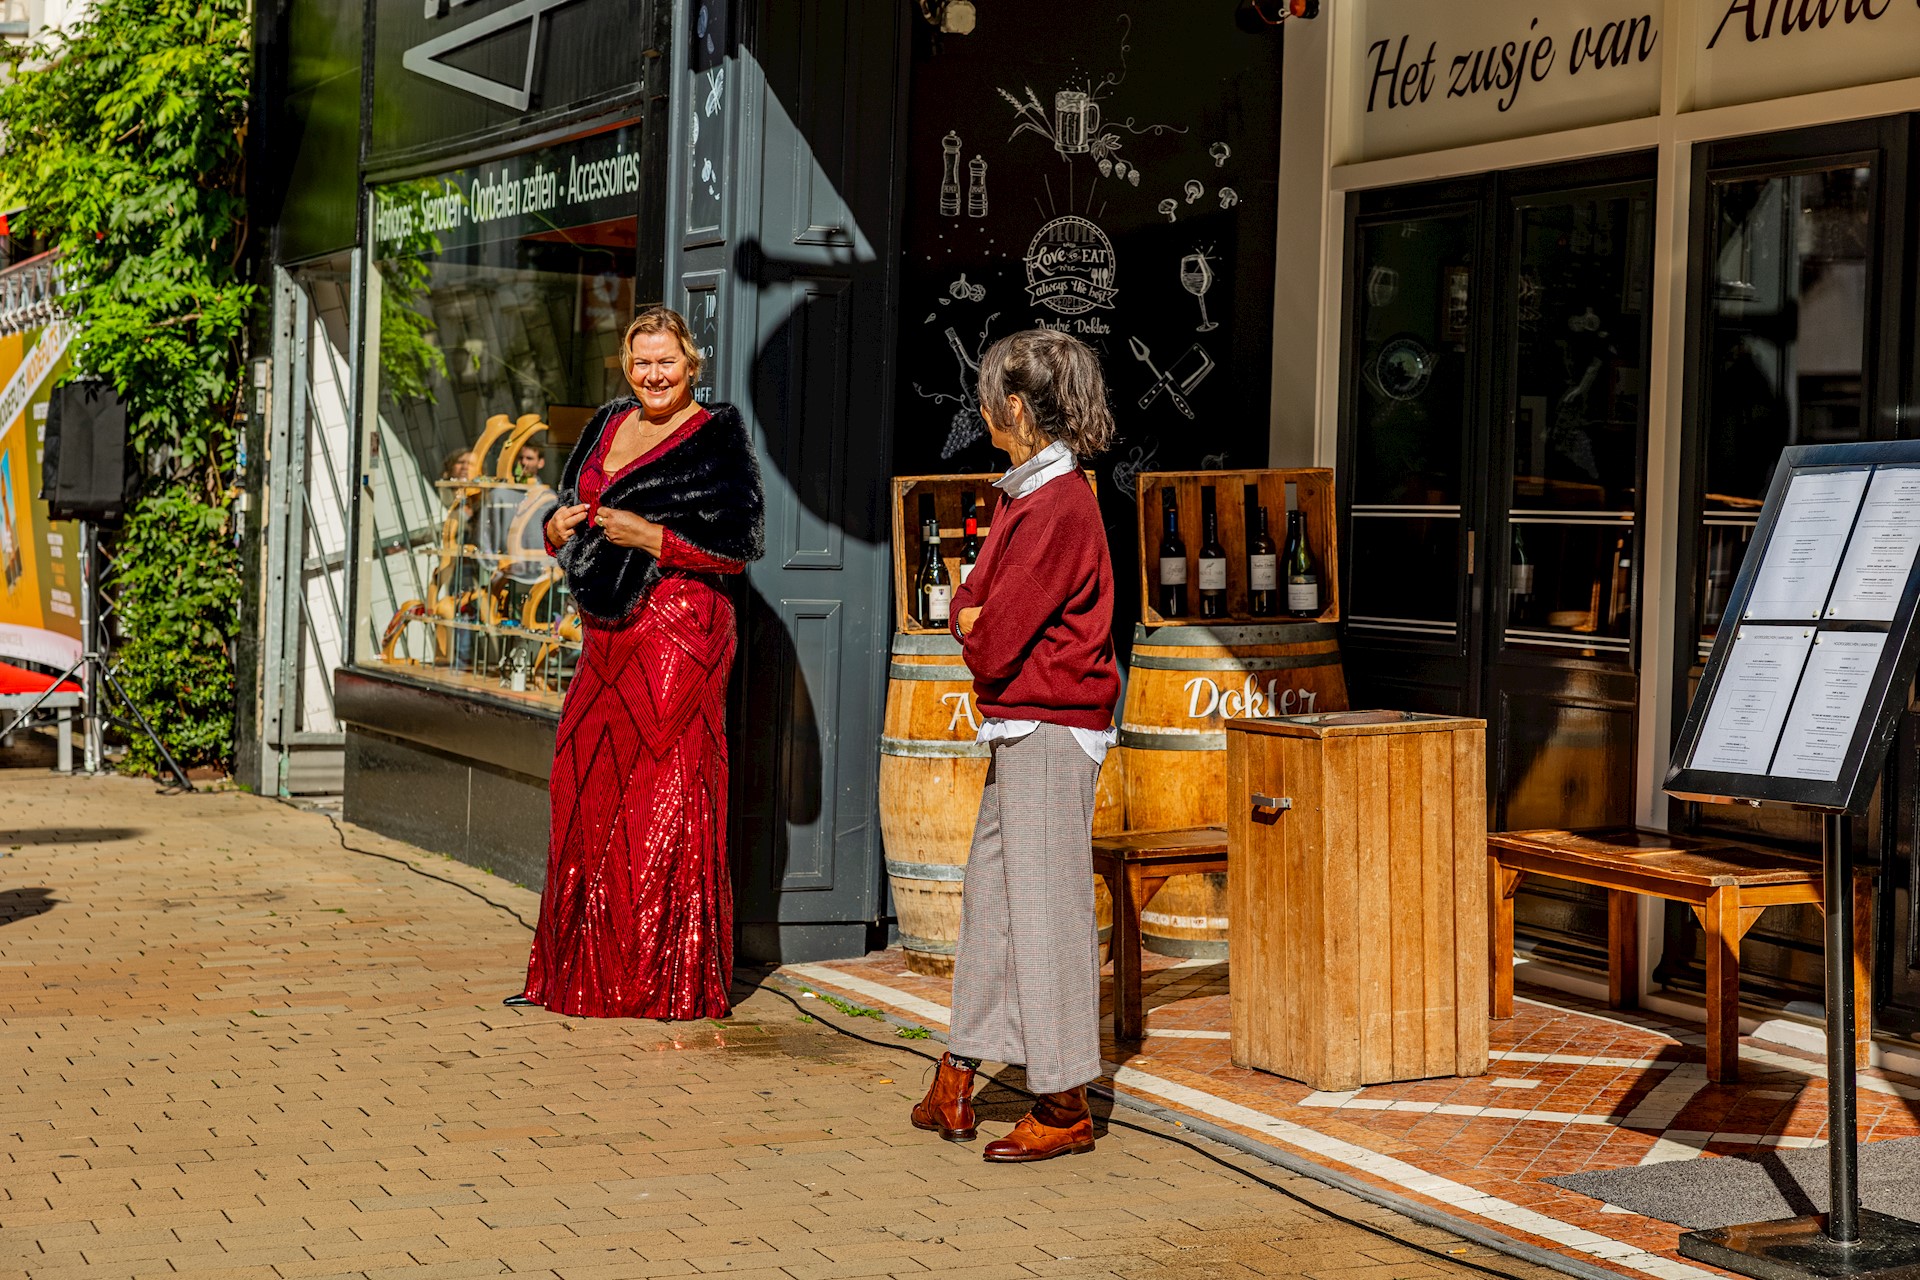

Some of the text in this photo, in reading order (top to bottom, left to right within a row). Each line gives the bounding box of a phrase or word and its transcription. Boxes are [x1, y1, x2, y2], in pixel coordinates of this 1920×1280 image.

[1367, 14, 1658, 112] Het zusje van
[471, 168, 520, 224] Oorbellen
[521, 165, 556, 214] zetten
[567, 144, 640, 205] Accessoires
[1048, 222, 1097, 243] PEOPLE
[1022, 246, 1066, 276] Love
[1082, 248, 1107, 263] EAT
[1035, 282, 1068, 296] always
[1034, 317, 1111, 334] André Dokter
[1184, 672, 1317, 719] Dokter
